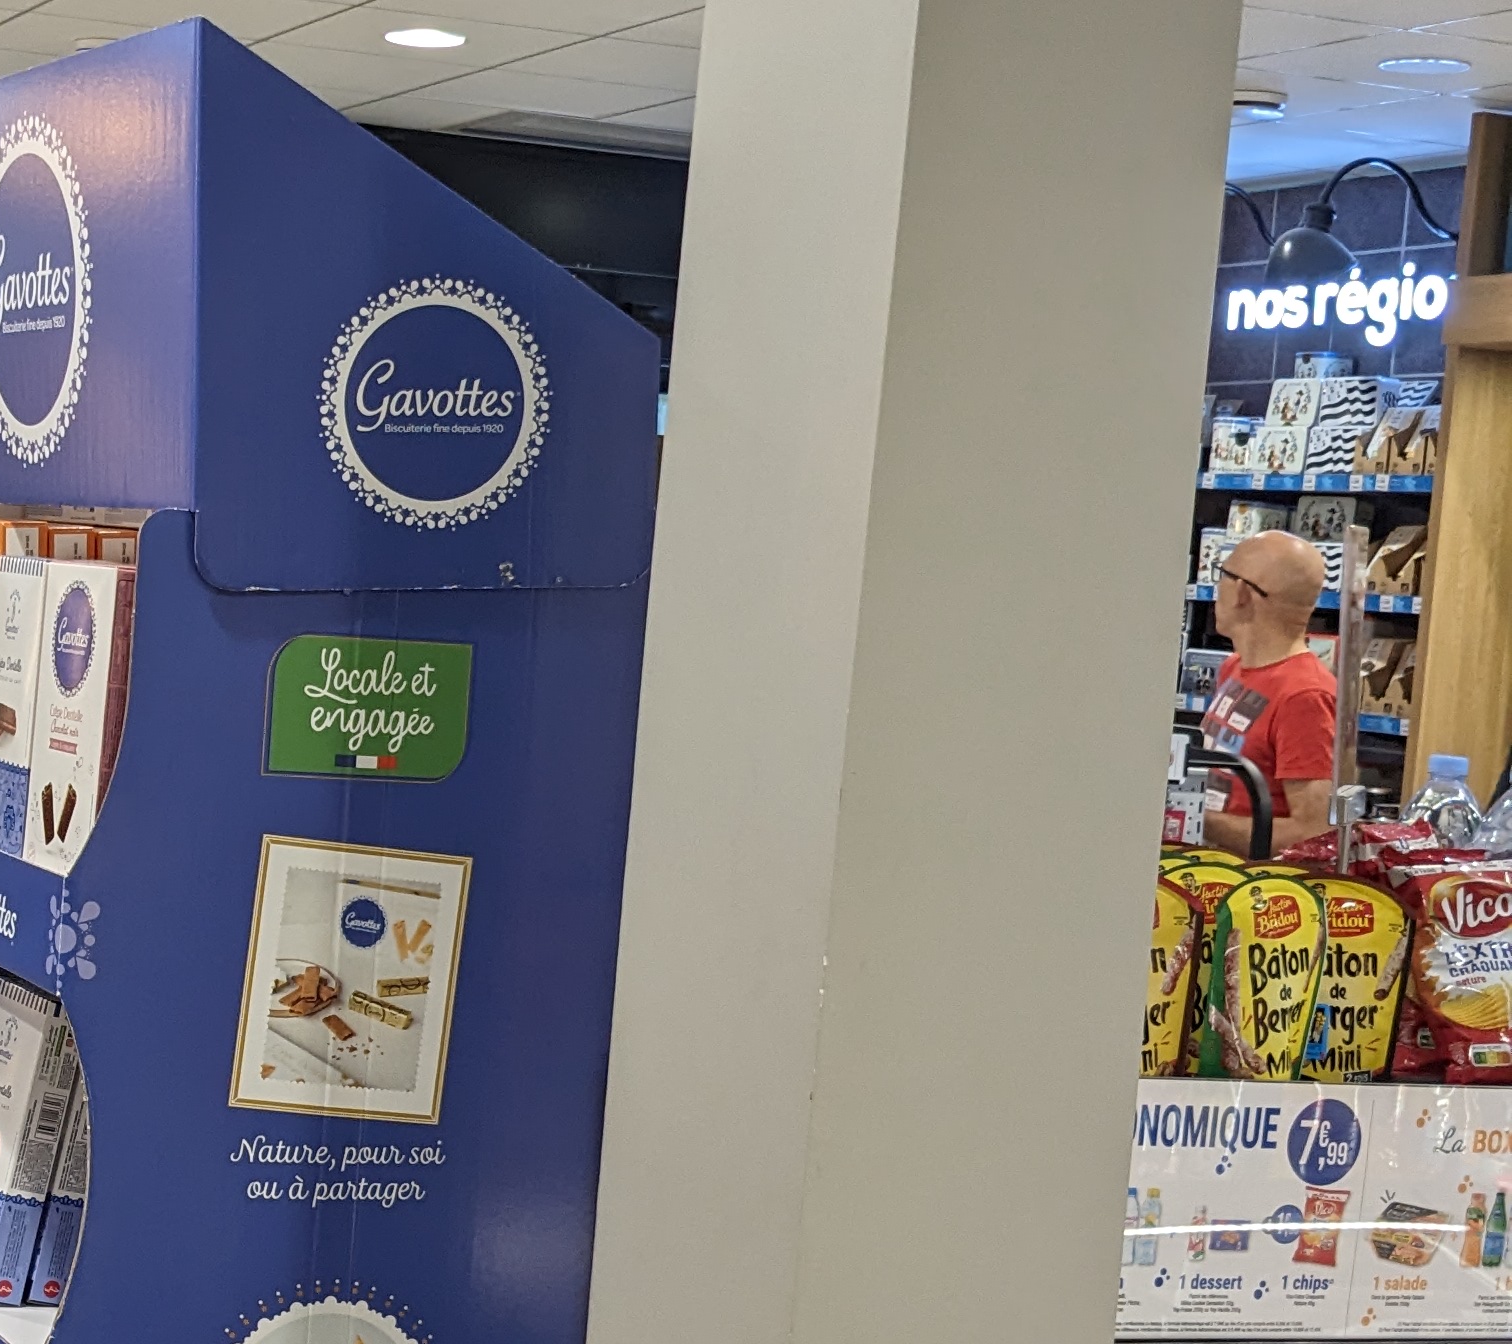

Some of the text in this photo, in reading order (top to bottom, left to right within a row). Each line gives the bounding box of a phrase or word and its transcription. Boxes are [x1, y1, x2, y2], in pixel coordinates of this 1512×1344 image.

[1227, 261, 1448, 347] nos régio
[3, 316, 65, 333] Biscuiterie fine depuis 1920
[356, 360, 514, 431] Gavottes
[385, 423, 503, 434] Biscuiterie fine depuis 1920
[304, 648, 436, 704] Locale et
[310, 707, 434, 752] engagée
[1258, 913, 1298, 933] Bridou
[1441, 887, 1512, 933] Vico
[1249, 943, 1309, 996] Bâton
[1280, 986, 1292, 1001] de
[1330, 984, 1346, 1000] de
[1330, 1005, 1377, 1046] rger
[1137, 1104, 1281, 1154] NOMIQUE
[1432, 1127, 1466, 1154] La
[230, 1135, 446, 1172] Nature, pour soi
[247, 1175, 425, 1208] ou à partager
[1179, 1274, 1242, 1290] 1 dessert
[1282, 1275, 1288, 1289] 1
[1373, 1275, 1428, 1291] 1 salade
